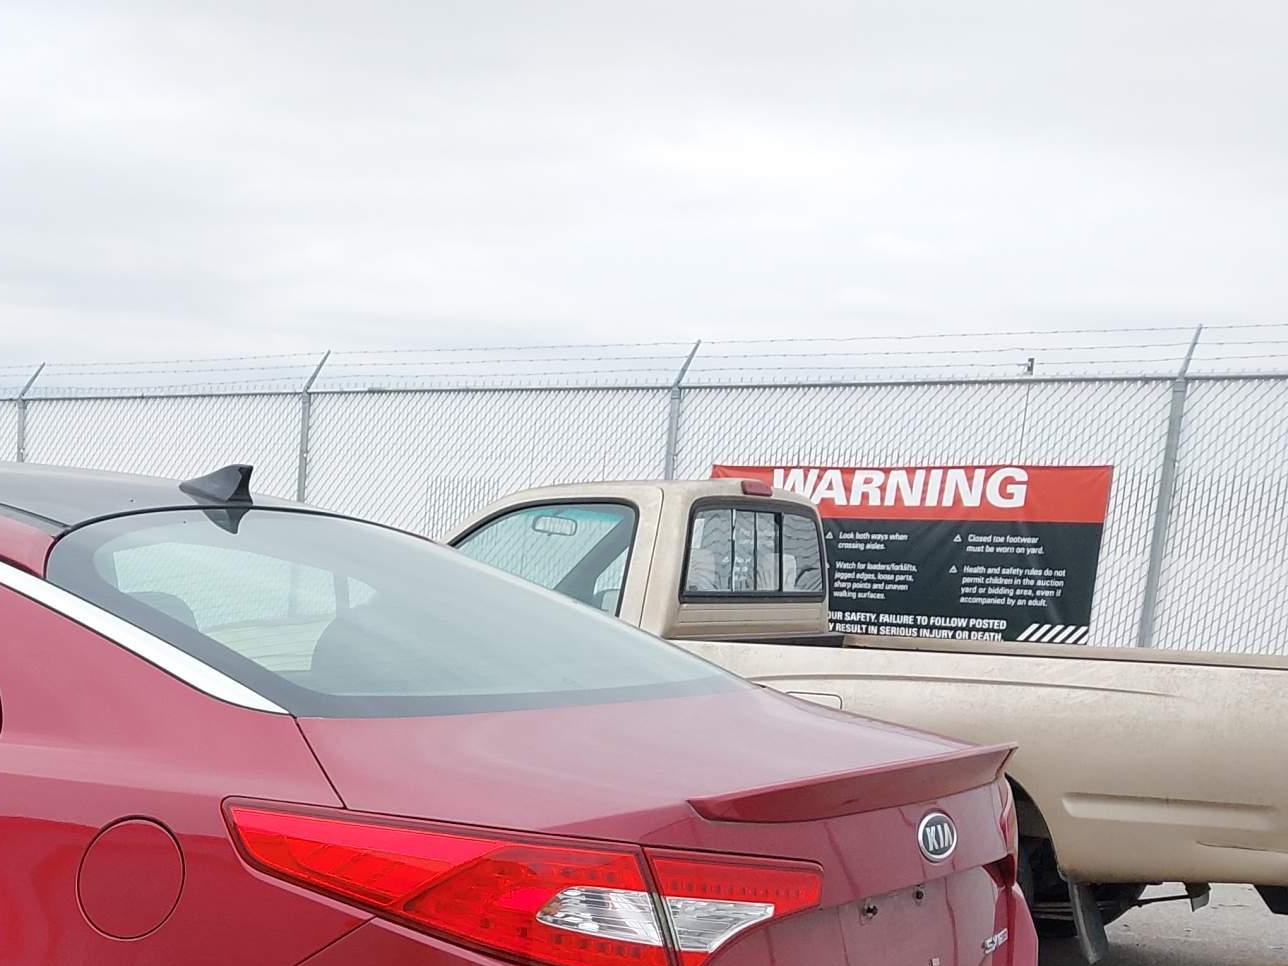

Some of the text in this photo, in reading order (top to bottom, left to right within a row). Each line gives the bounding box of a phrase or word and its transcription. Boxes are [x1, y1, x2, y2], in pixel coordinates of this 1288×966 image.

[772, 467, 1029, 508] WARNING
[839, 531, 854, 539] Look
[871, 533, 888, 541] ways
[968, 534, 1039, 544] Closed toe footwear
[838, 542, 864, 550] crossing
[985, 545, 994, 553] be
[1015, 546, 1025, 554] on
[1026, 546, 1045, 555] yard.
[835, 561, 856, 569] Watch
[857, 562, 866, 570] for
[834, 571, 855, 580] jagged
[877, 572, 894, 580] loose
[963, 565, 1066, 577] Health and safety rules do not
[834, 580, 851, 589] sharp
[852, 581, 871, 590] points
[872, 581, 884, 589] and
[962, 576, 1064, 586] permit children in the auction
[833, 590, 886, 599] walking surfaces.
[960, 585, 977, 594] yard
[987, 586, 1014, 596] bidding
[1015, 588, 1034, 596] area,
[1055, 588, 1062, 597] if
[959, 596, 1005, 605] accompanied
[1006, 597, 1015, 606] by
[1028, 598, 1048, 607] adult.
[828, 611, 843, 620] OUR
[879, 613, 914, 624] FAILURE
[916, 615, 928, 625] TO
[929, 616, 968, 627] FOLLOW
[969, 618, 1007, 629] POSTED
[835, 622, 867, 633] RESULT
[868, 625, 878, 634] IN
[879, 626, 918, 637] SERIOUS
[919, 628, 954, 639] INJURY
[955, 630, 969, 640] OR
[925, 822, 953, 851] KIA
